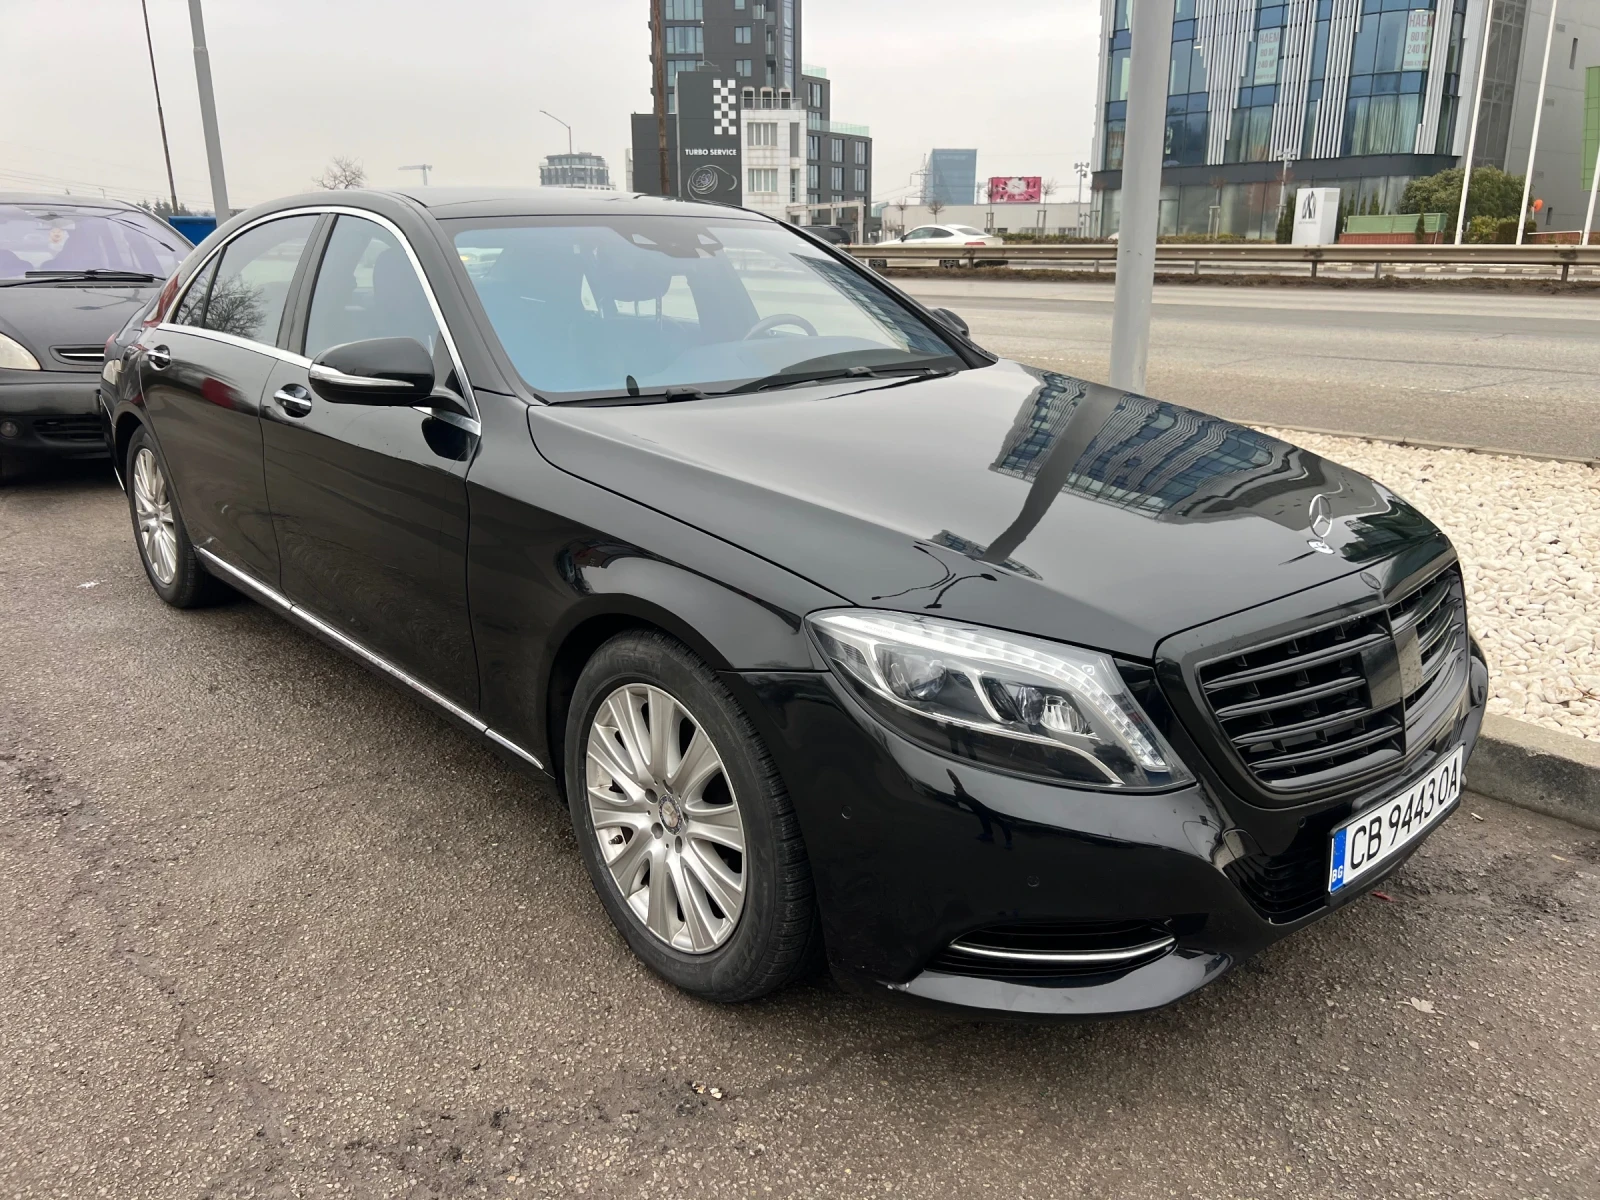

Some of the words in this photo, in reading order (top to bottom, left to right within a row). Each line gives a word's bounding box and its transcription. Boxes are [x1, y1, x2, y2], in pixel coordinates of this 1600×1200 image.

[1350, 815, 1382, 870] CB
[1388, 777, 1436, 847] 9443
[1438, 757, 1457, 806] OA
[1331, 865, 1344, 883] BG
